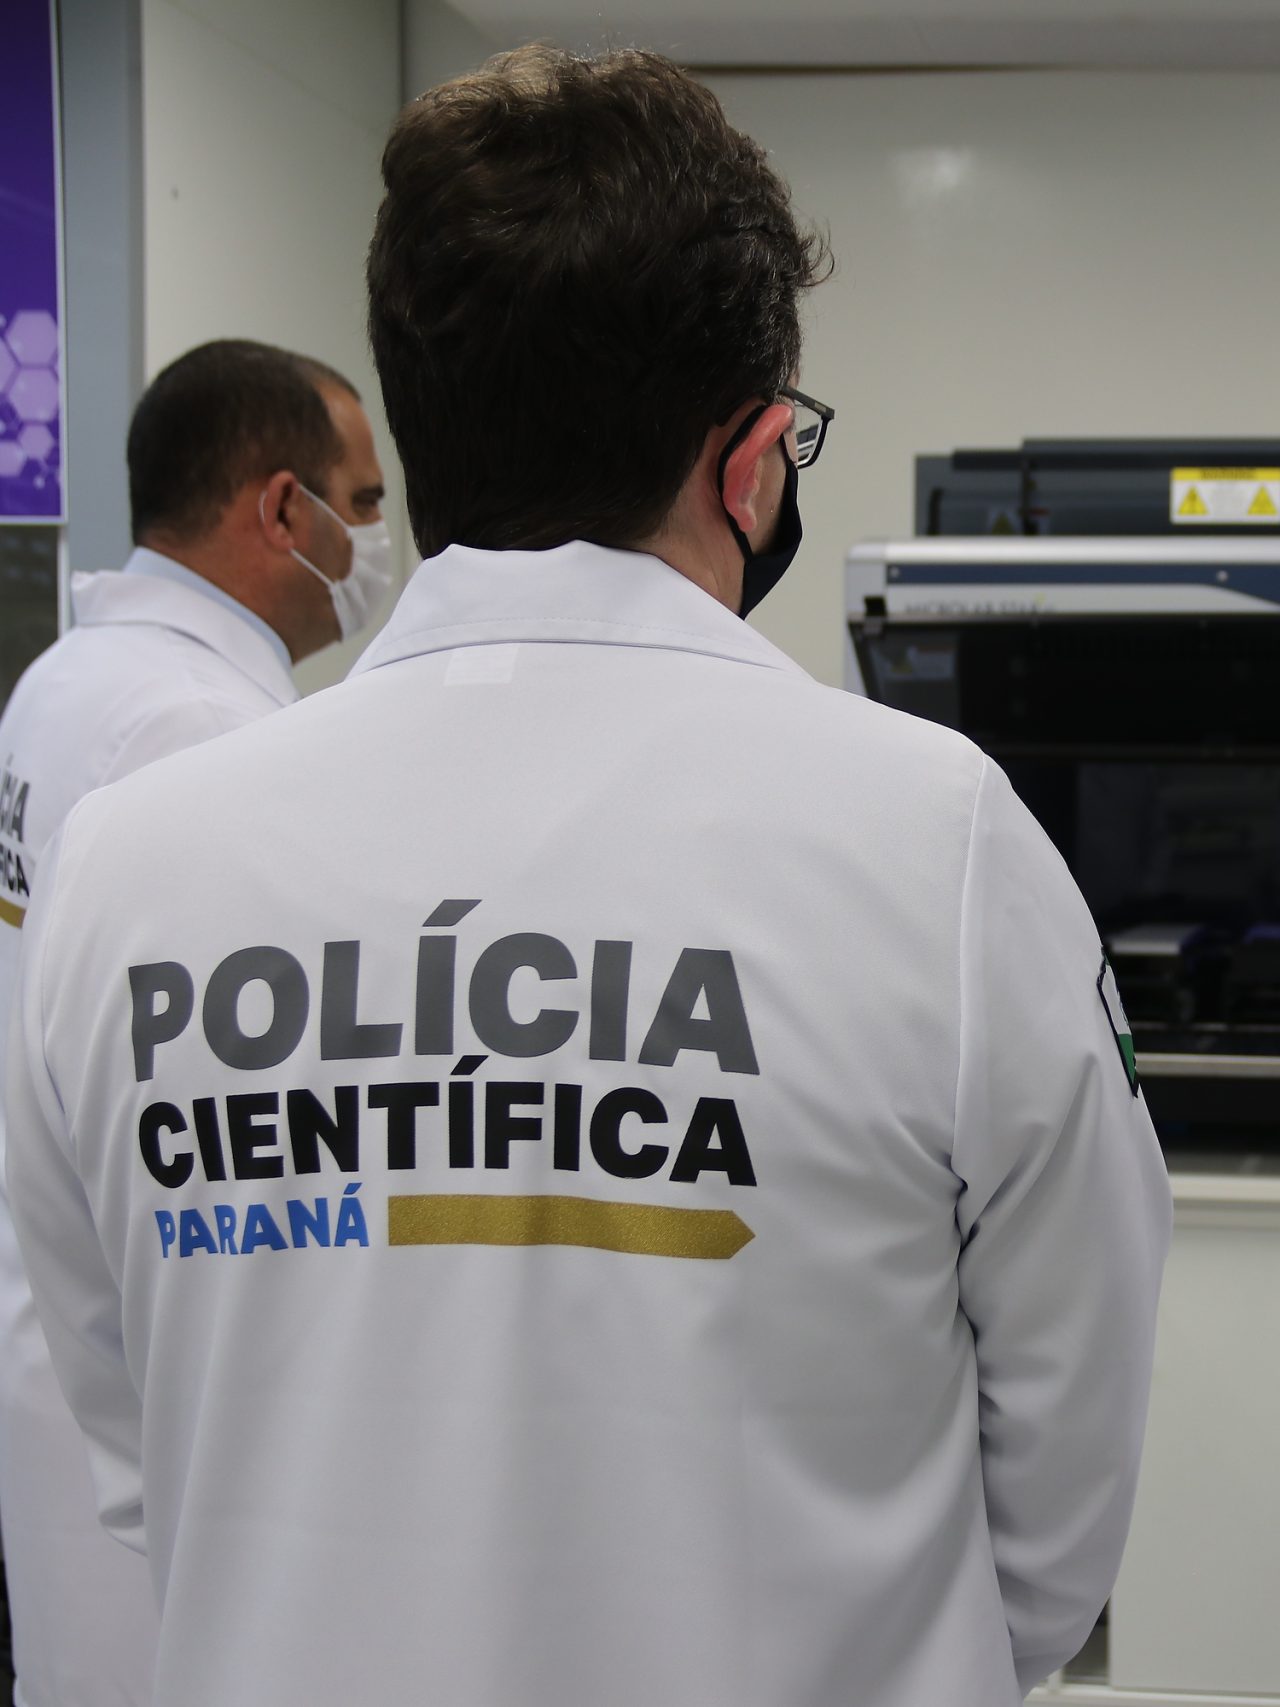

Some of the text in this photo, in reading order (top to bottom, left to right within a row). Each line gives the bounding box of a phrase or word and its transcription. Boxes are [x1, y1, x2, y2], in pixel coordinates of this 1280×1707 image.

[129, 900, 760, 1083] POLÍCIA
[138, 1055, 758, 1189] CIENTÍFICA
[154, 1182, 369, 1258] PARANÁ
